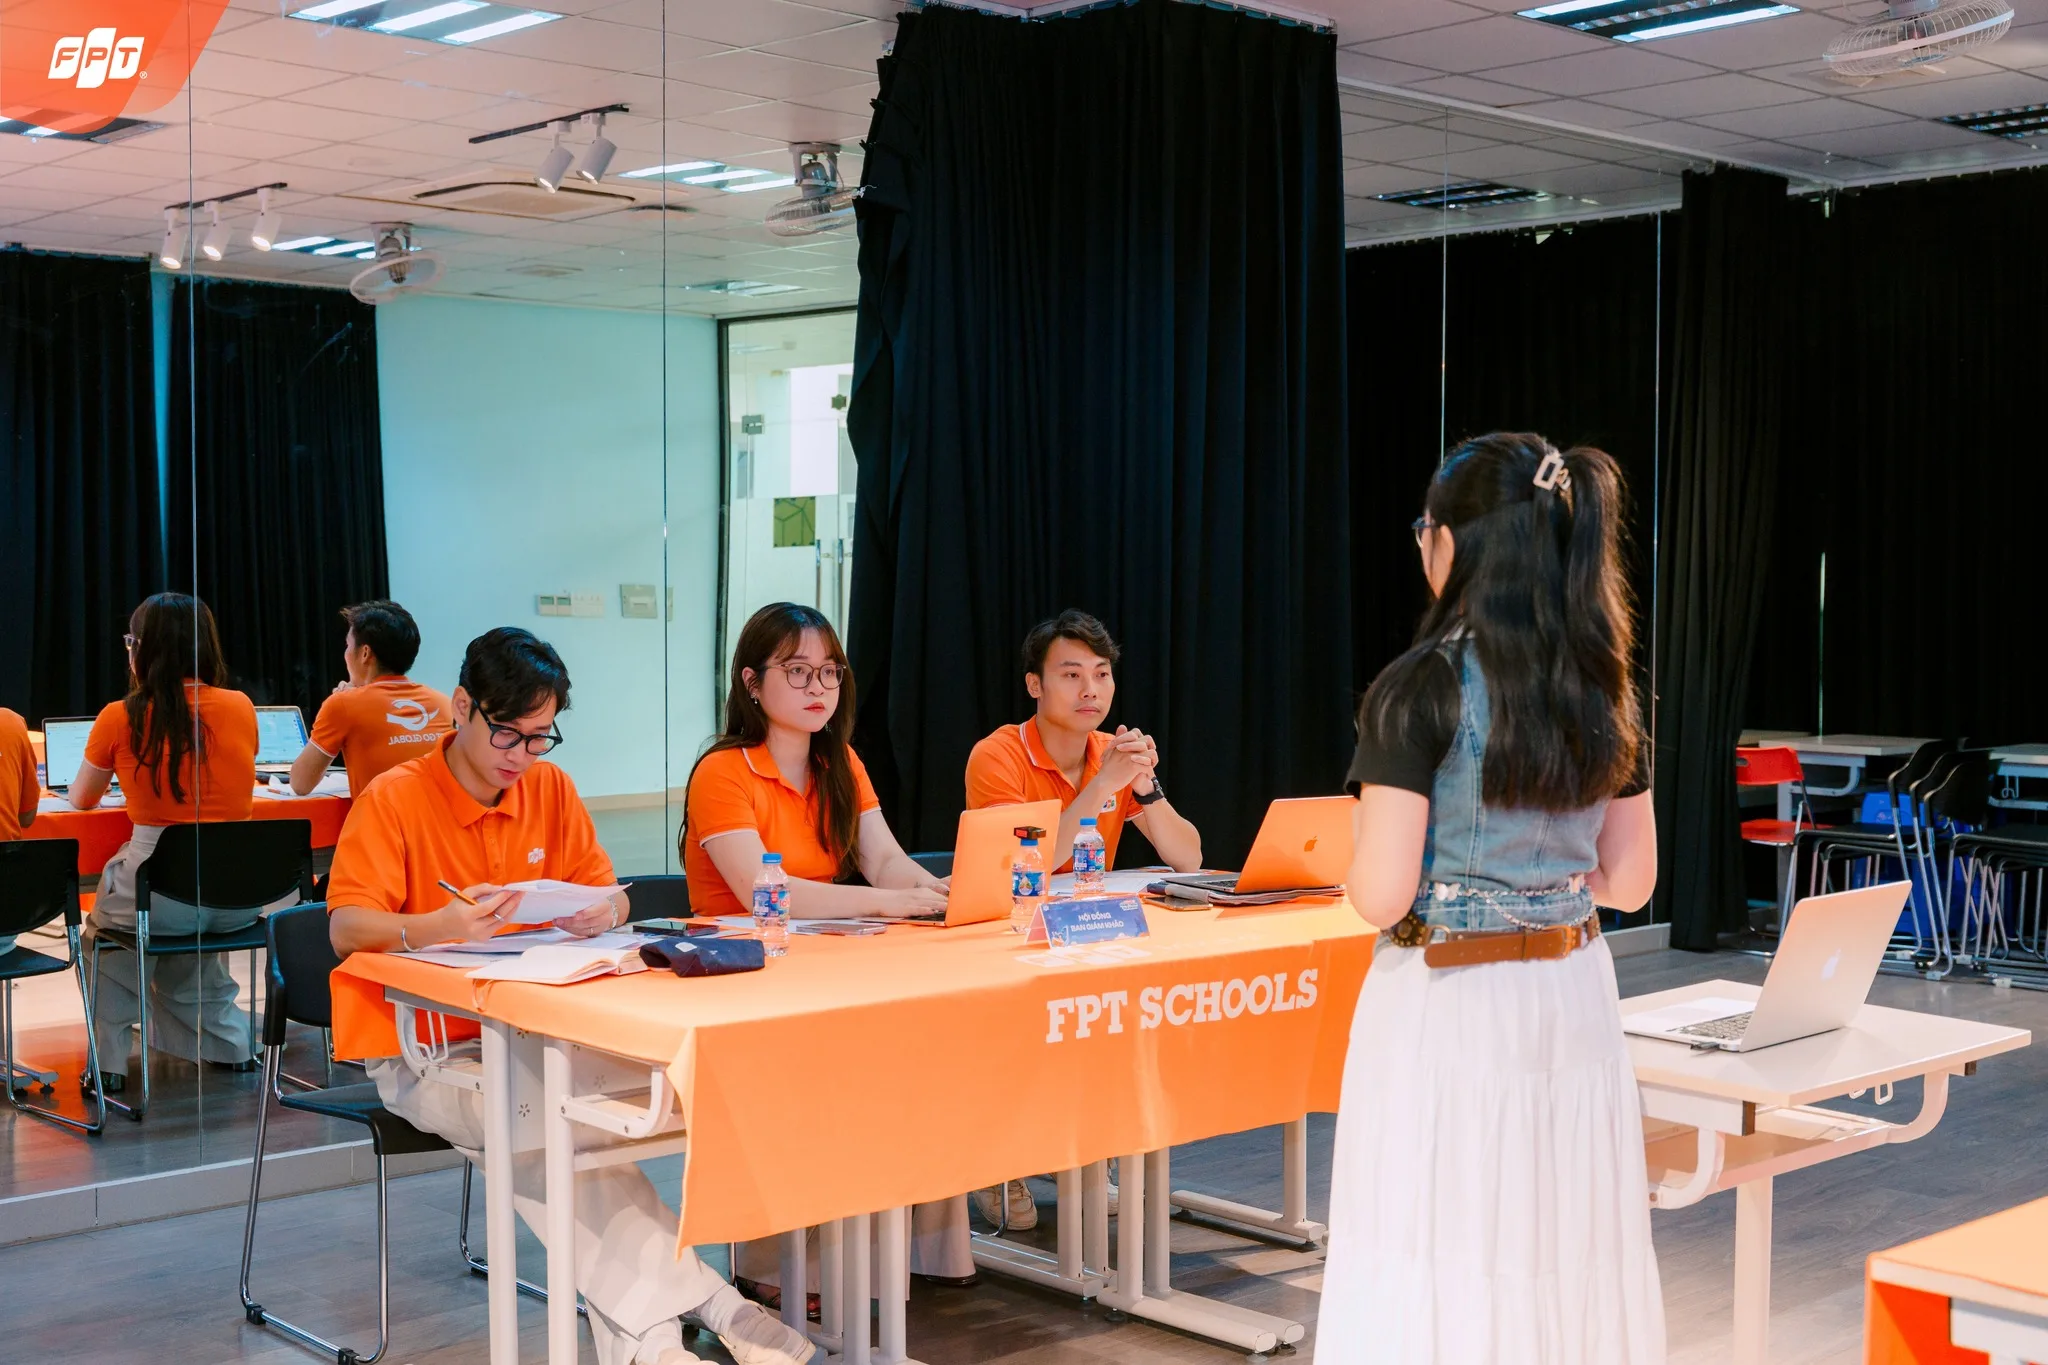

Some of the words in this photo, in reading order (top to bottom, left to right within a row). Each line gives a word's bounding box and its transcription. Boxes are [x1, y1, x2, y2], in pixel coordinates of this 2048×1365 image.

[1070, 923, 1086, 932] BAN
[1046, 990, 1128, 1044] FPT
[1139, 968, 1318, 1030] SCHOOLS
